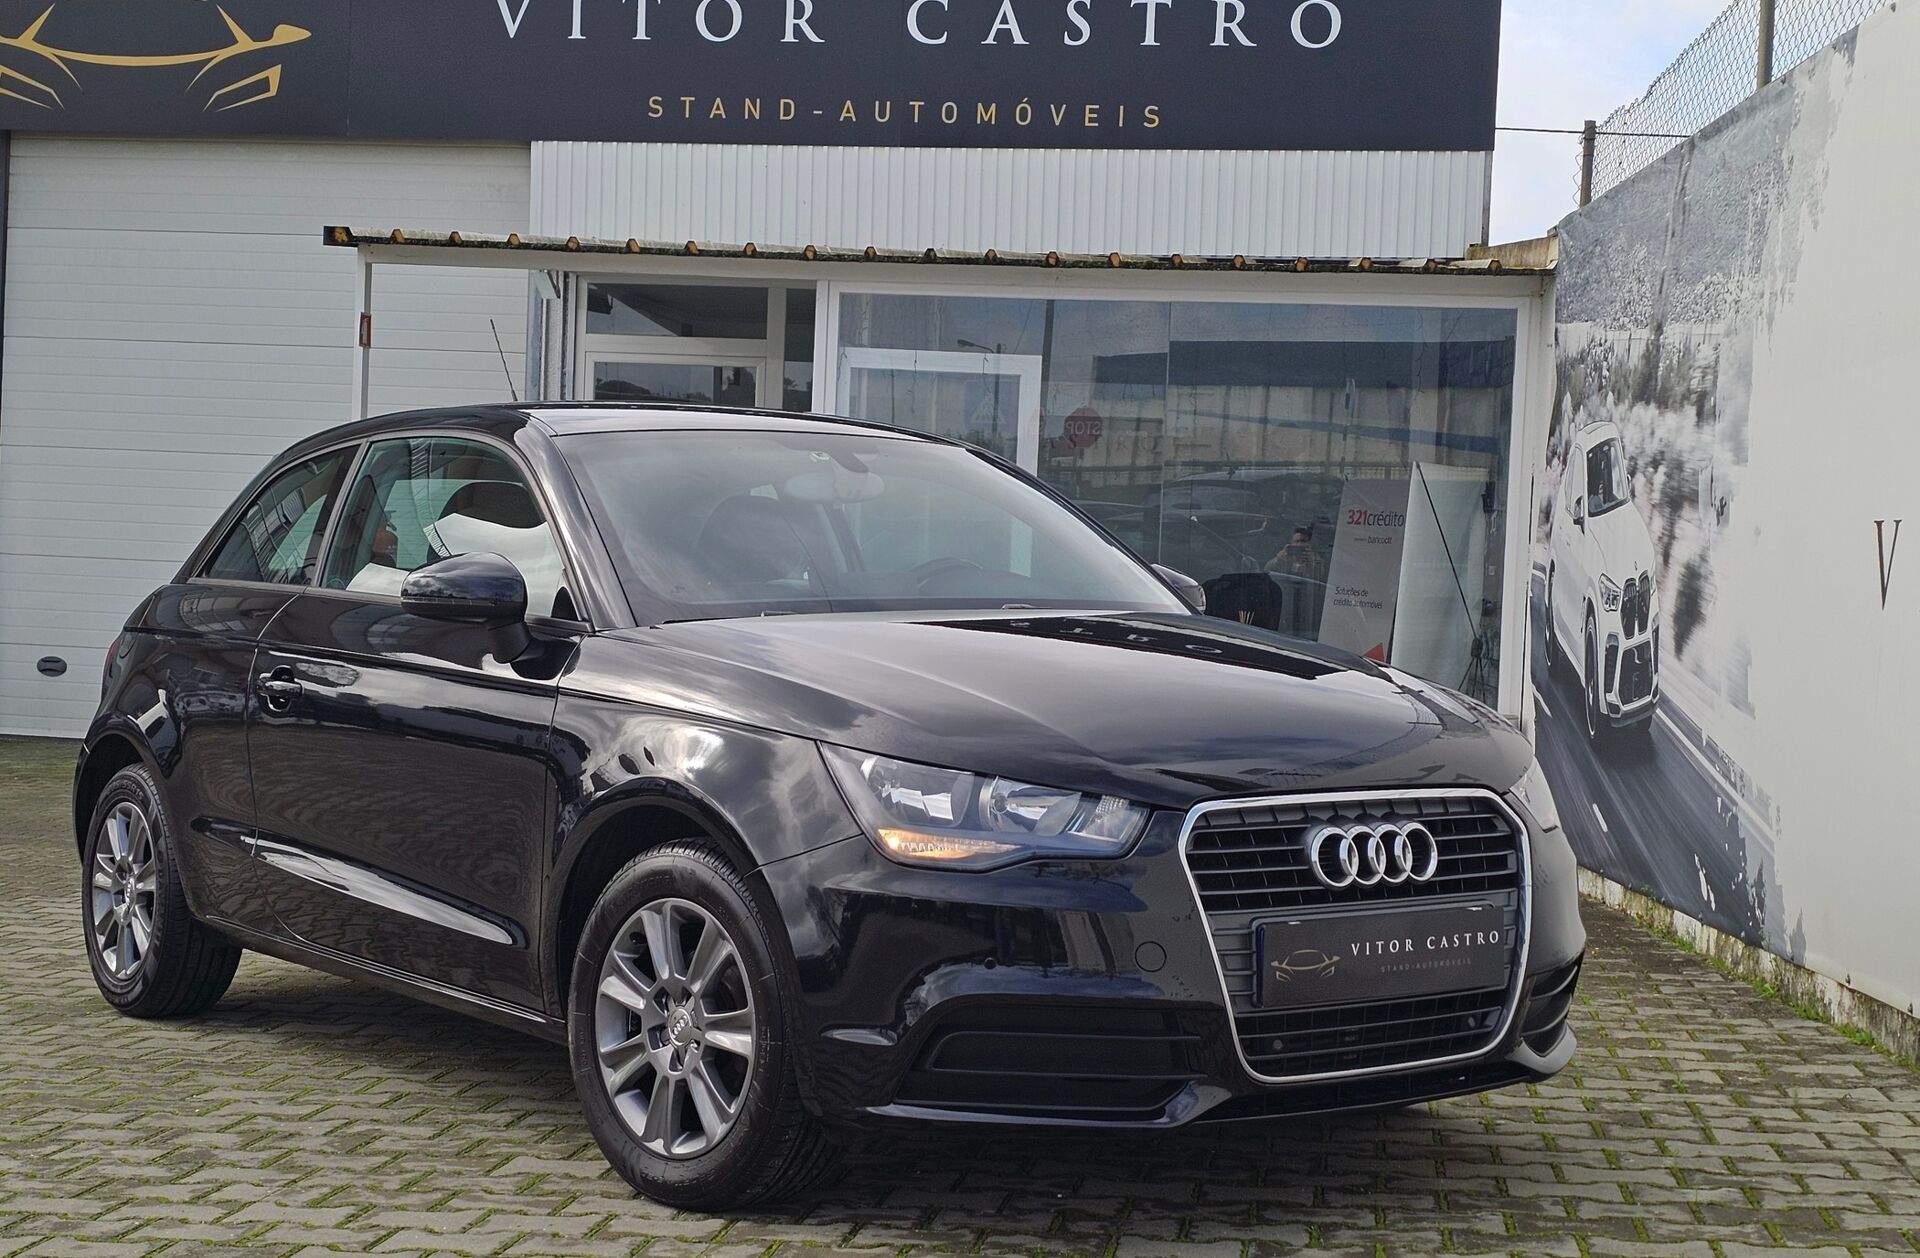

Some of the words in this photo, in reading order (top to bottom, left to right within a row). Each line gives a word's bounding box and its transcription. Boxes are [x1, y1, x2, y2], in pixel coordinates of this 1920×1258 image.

[497, 0, 825, 42] VITOR
[906, 0, 1342, 48] CASTRO
[647, 96, 1161, 128] STAND-AUTOMÓVEIS
[1346, 509, 1405, 527] 321crédito
[1351, 938, 1414, 957] VITOR
[1426, 930, 1500, 950] CASTRO
